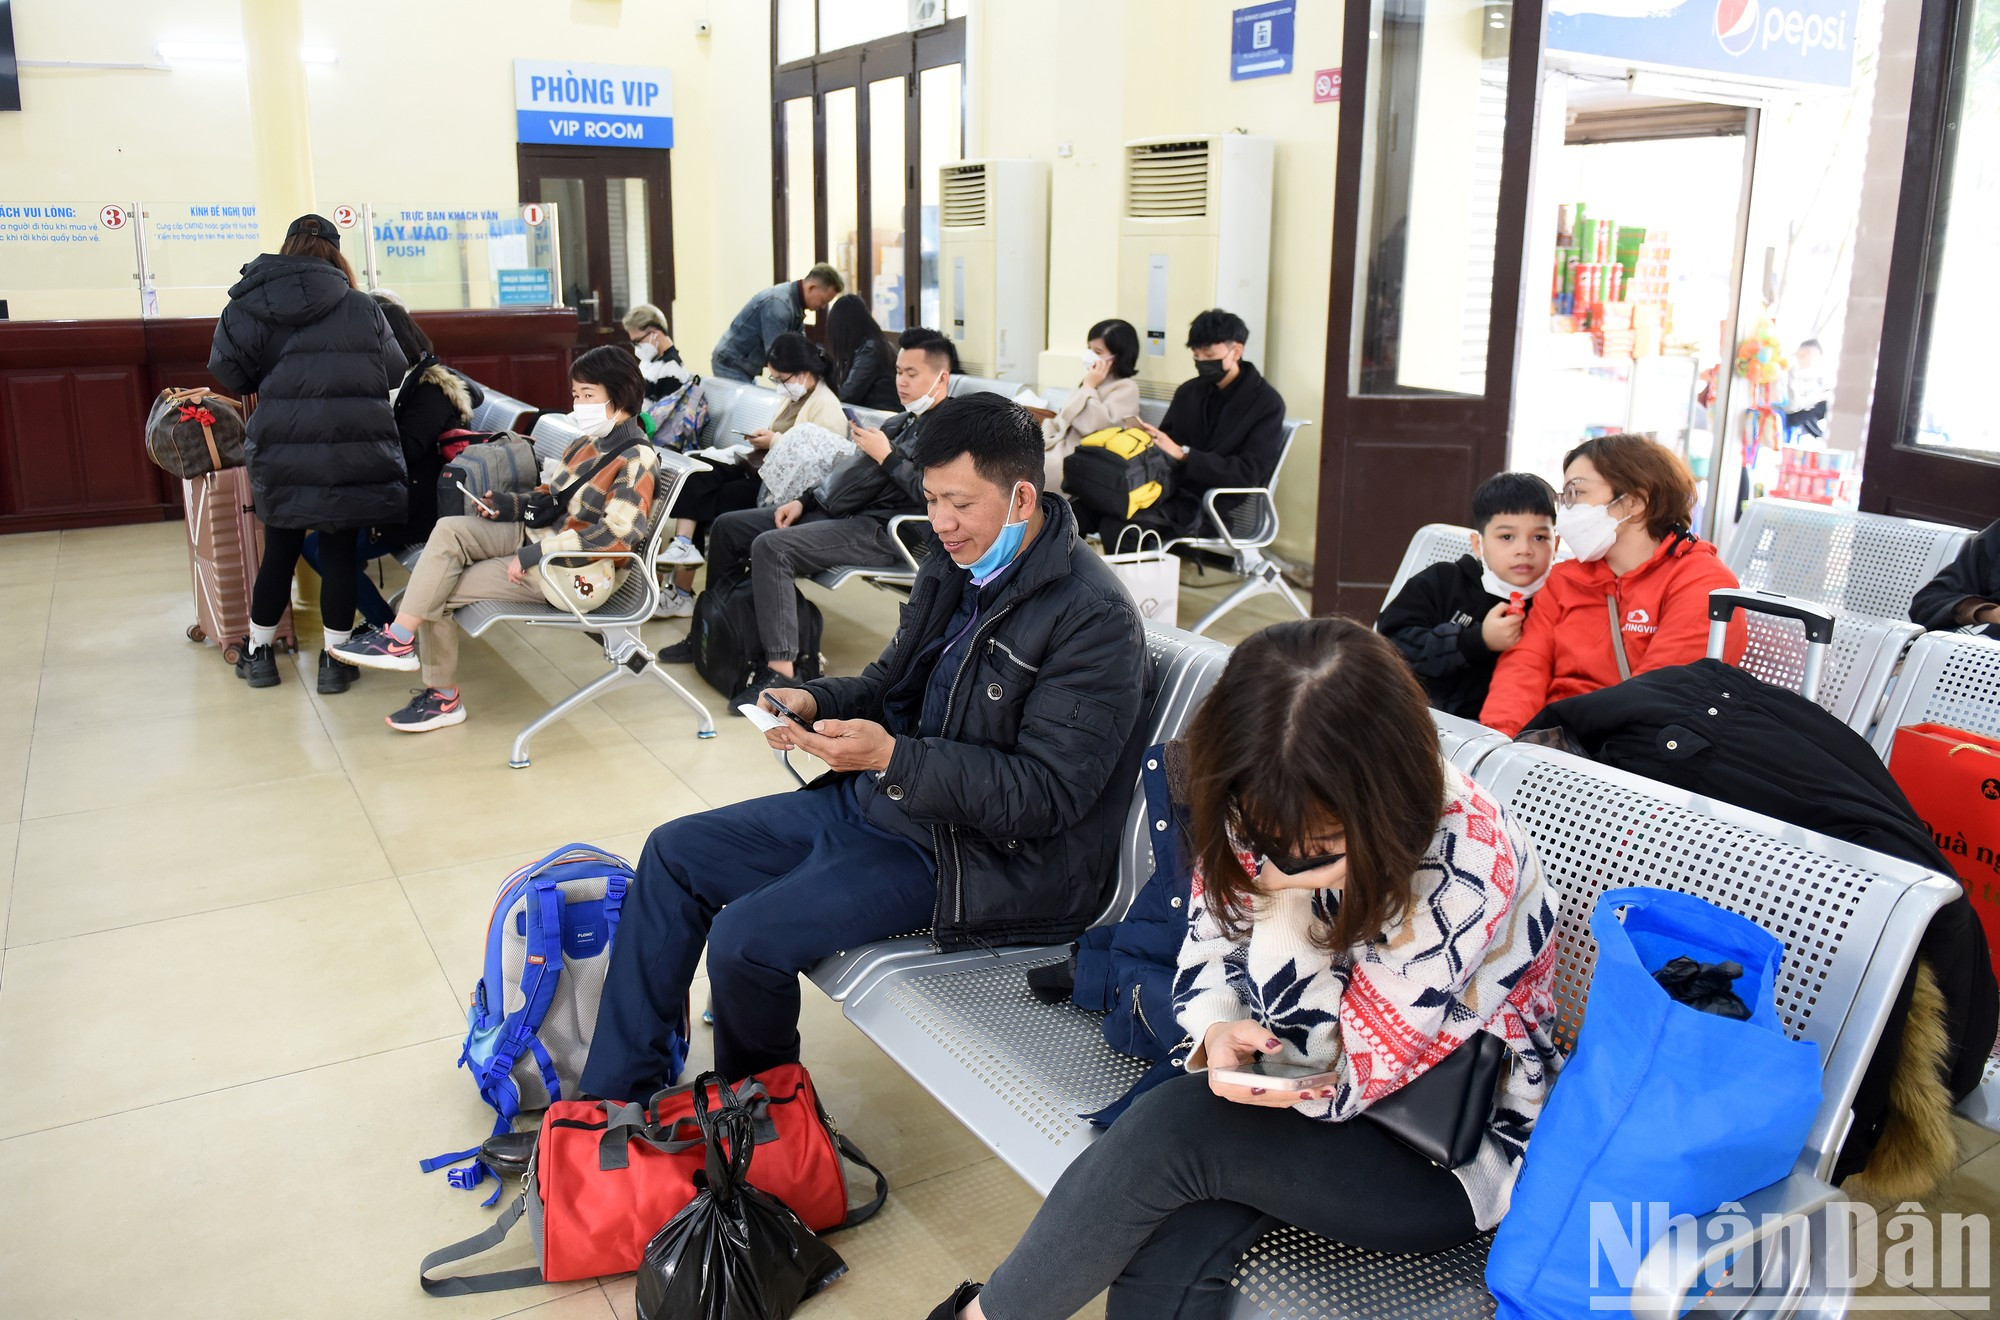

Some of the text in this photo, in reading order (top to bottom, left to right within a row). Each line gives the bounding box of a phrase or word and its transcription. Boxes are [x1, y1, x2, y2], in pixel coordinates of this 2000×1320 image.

[1762, 6, 1847, 56] pepsi
[531, 69, 659, 107] PHÒNG VIP
[549, 119, 644, 140] VIP ROOM
[24, 207, 41, 218] VUI
[45, 205, 76, 218] LÒNG:
[106, 209, 122, 226] 3
[190, 204, 209, 217] KÍNH
[222, 206, 241, 218] NGHỊ
[339, 209, 352, 224] 2
[401, 210, 424, 222] TRỰC
[427, 211, 446, 221] BAN
[531, 207, 537, 222] 1
[56, 222, 68, 231] khi
[413, 221, 448, 241] VÀO
[6, 233, 18, 241] khi
[386, 245, 426, 257] PUSH
